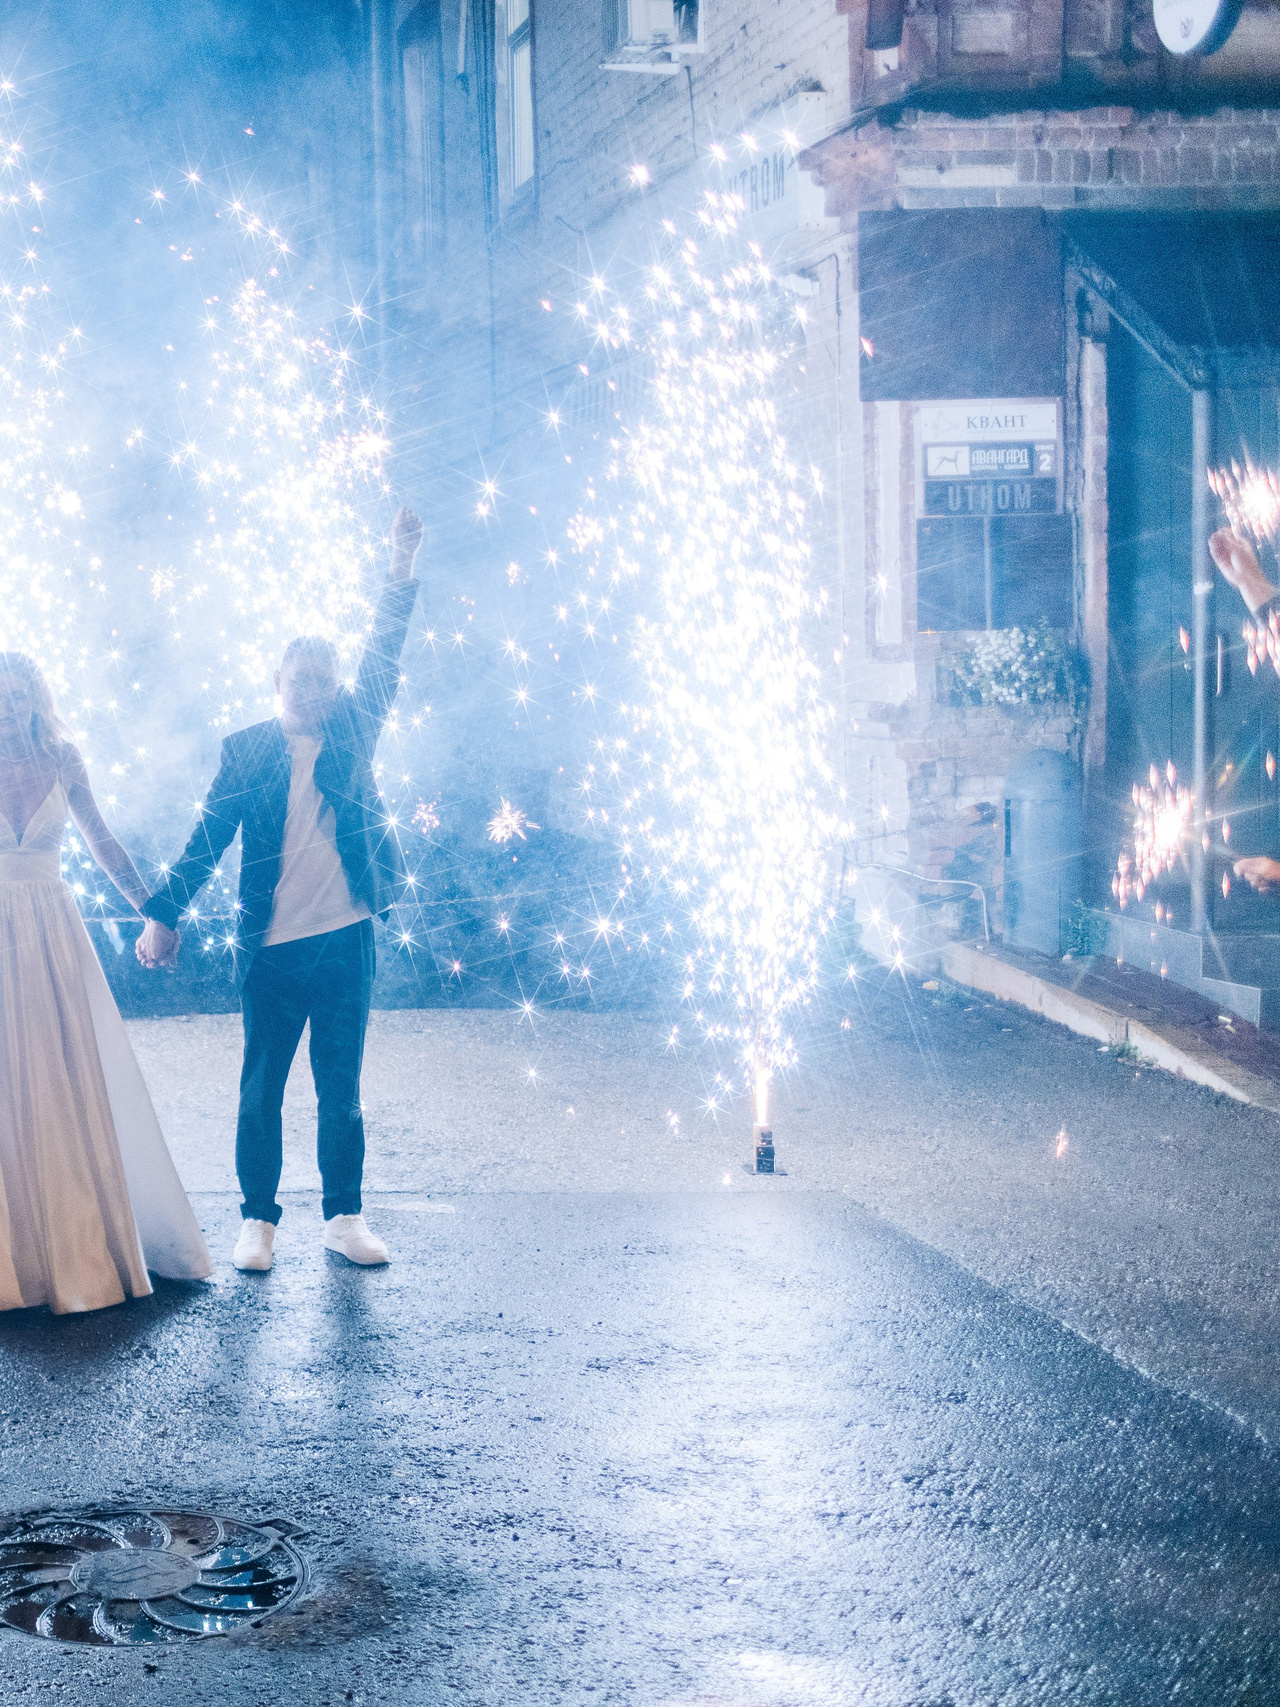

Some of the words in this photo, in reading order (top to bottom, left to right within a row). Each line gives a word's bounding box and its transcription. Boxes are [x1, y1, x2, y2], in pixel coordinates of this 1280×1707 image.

[966, 415, 1028, 429] КВАНТ
[972, 448, 1029, 465] АВАНГАРД
[1039, 454, 1052, 471] 2
